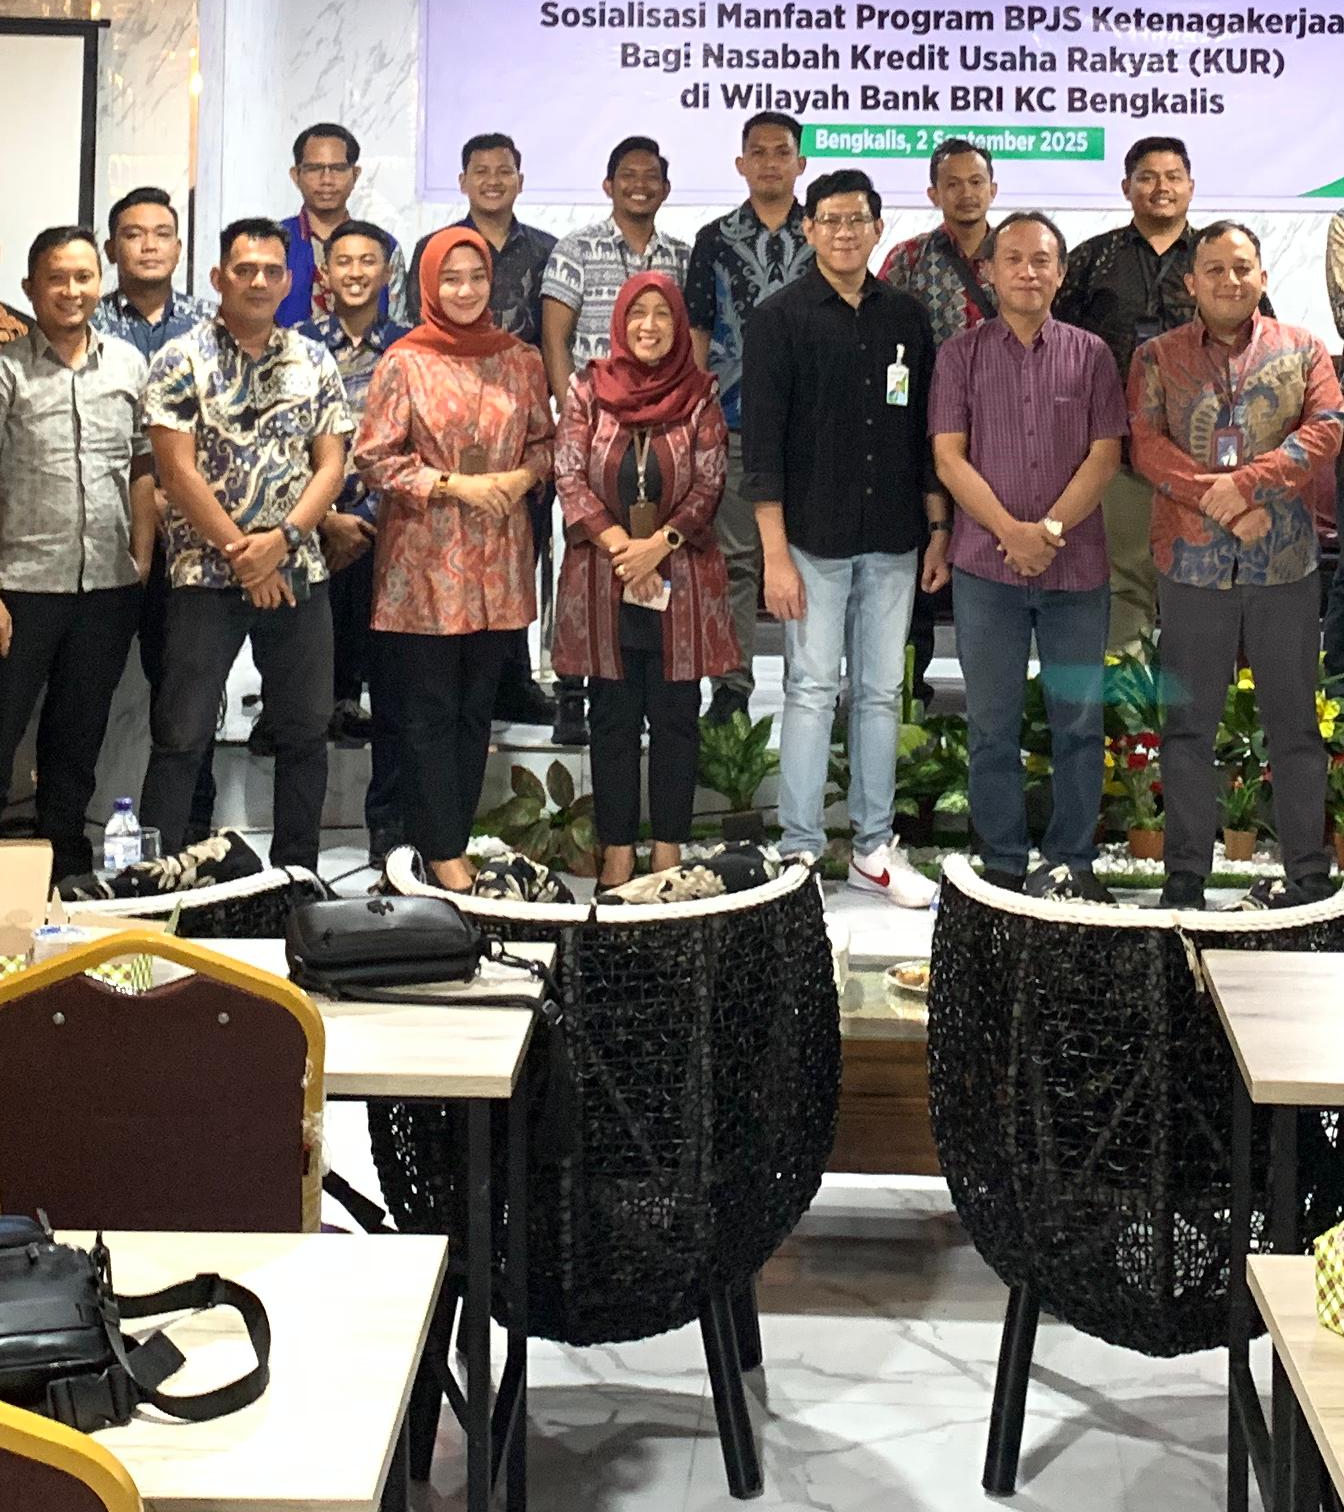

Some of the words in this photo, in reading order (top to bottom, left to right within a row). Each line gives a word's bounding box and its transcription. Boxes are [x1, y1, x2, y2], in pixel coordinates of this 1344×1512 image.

[540, 1, 706, 28] Sosialisasi
[717, 2, 847, 29] Manfaat
[856, 3, 994, 35] Program
[1004, 5, 1082, 32] BPJS
[621, 42, 691, 73] Bagi
[703, 42, 840, 69] Nasabah
[850, 43, 950, 71] Kredit
[959, 45, 1057, 72] Usaha
[1067, 46, 1179, 78] Rakyat
[1188, 47, 1285, 79] (KUR)
[680, 82, 710, 109] di
[720, 82, 850, 115] Wilayah
[860, 84, 940, 111] Bank
[950, 85, 1004, 112] BRI
[1014, 86, 1057, 113] KC
[1067, 86, 1225, 118] Bengkalis
[815, 128, 912, 154] Bengkalis,
[916, 128, 928, 150] 2
[932, 130, 1035, 152] Stember
[1040, 131, 1089, 152] 2025
